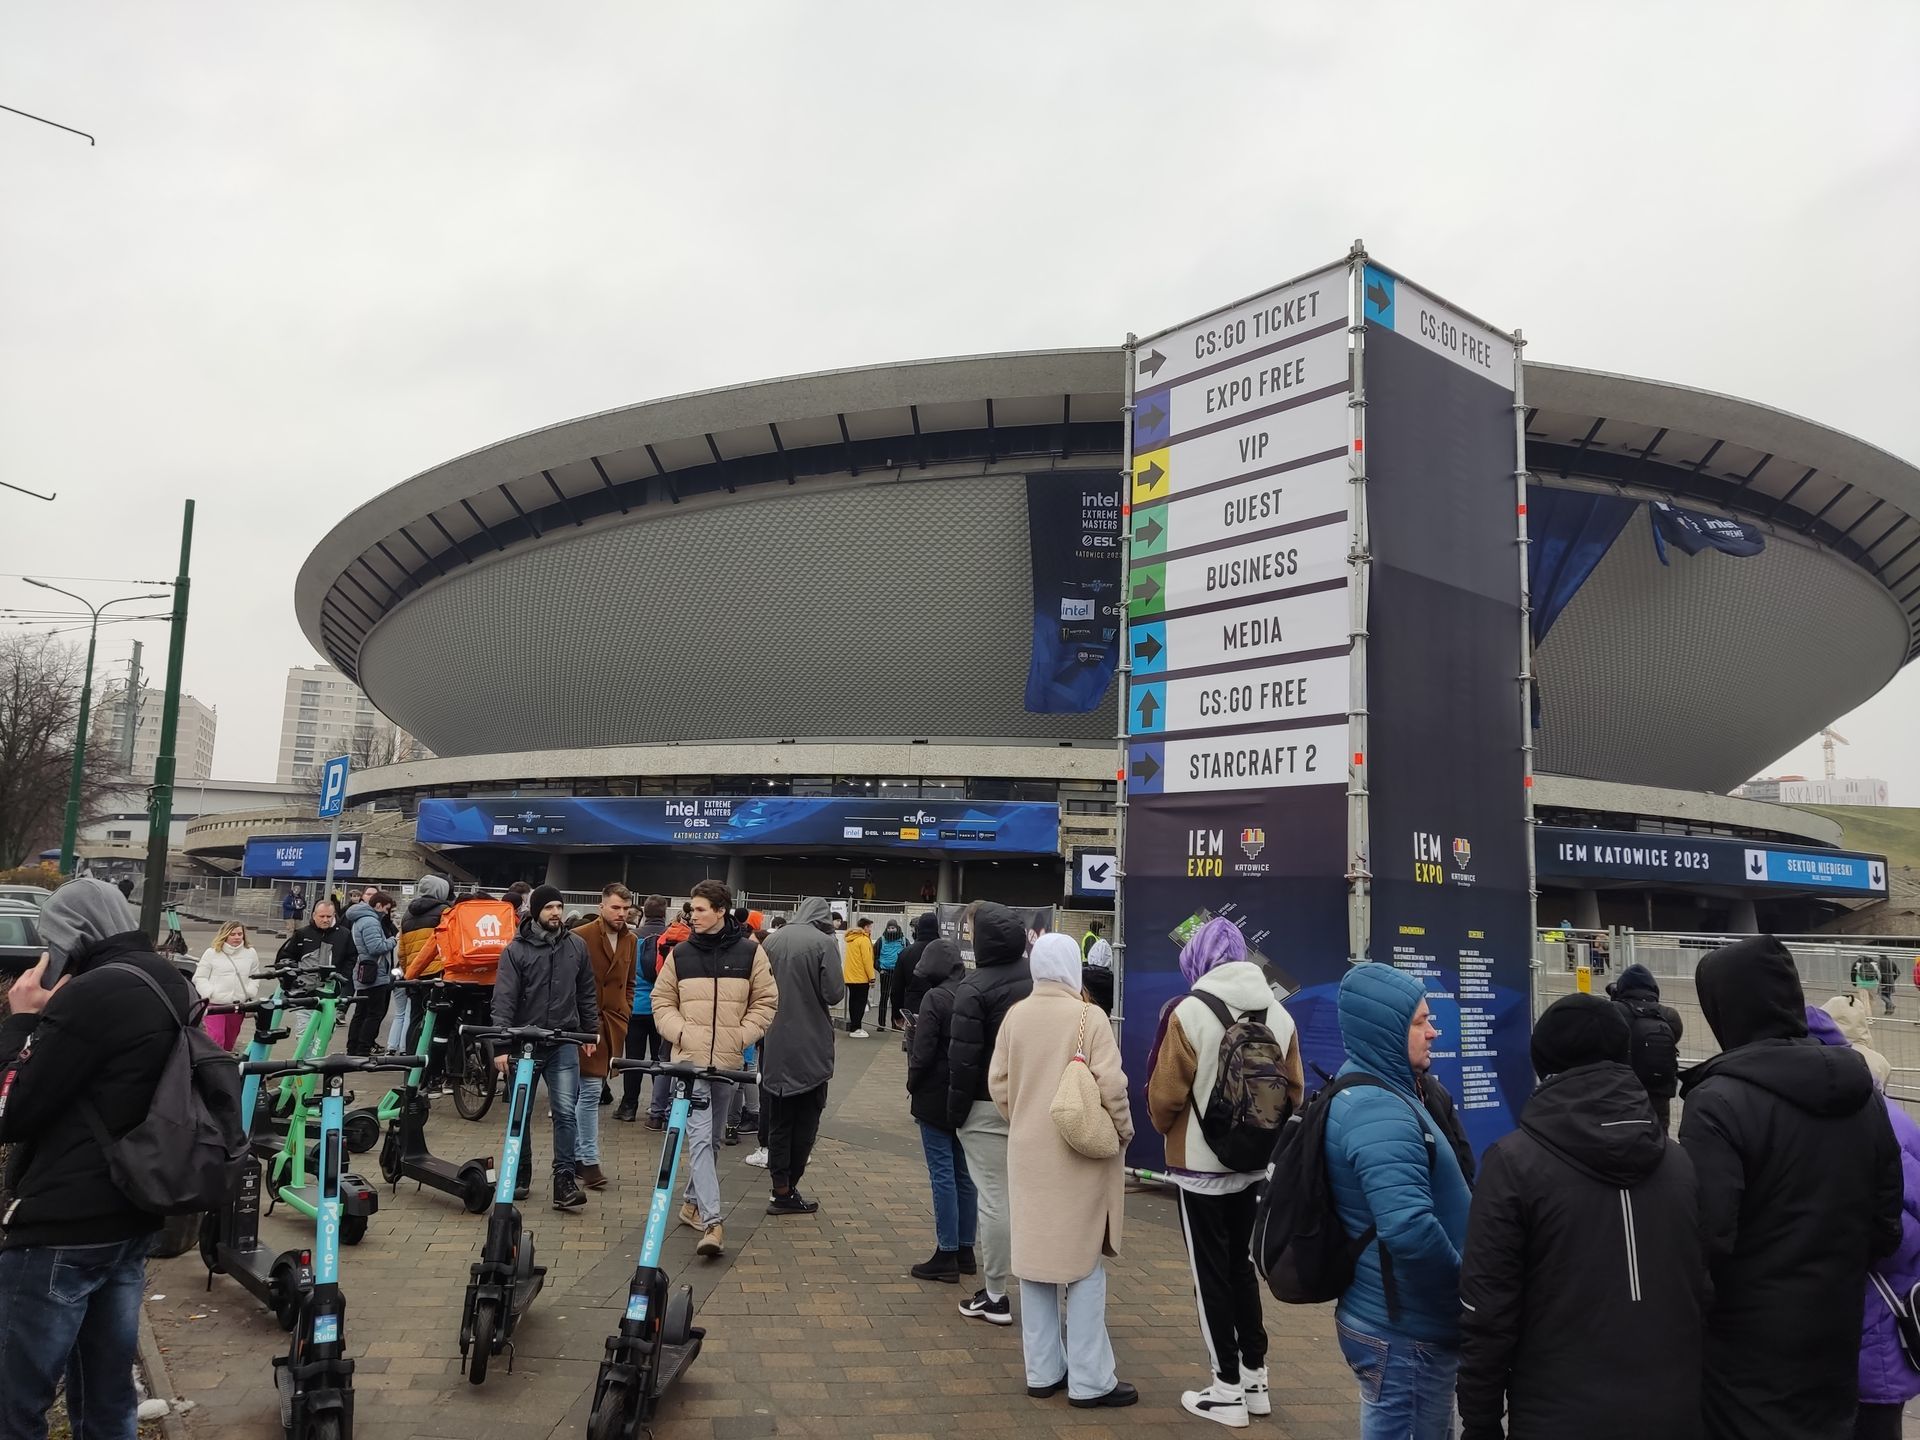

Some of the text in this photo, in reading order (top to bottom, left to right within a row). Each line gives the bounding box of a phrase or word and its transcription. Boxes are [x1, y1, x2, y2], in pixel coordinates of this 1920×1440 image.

[1195, 290, 1320, 359] CS:GO TICKET
[1419, 310, 1491, 369] CS:GO FREE
[1206, 357, 1305, 414] EXPO FREE
[1239, 432, 1269, 463] VIP
[1082, 510, 1118, 519] EXTREME
[1224, 488, 1283, 527] GUEST
[1082, 519, 1118, 530] MASTERS
[1093, 536, 1116, 547] ESL
[1206, 549, 1298, 592] BUSINESS
[1223, 616, 1283, 651] MEDIA
[1199, 678, 1308, 716] CS:GO FREE
[1190, 744, 1317, 780] STARCRAFT 2
[325, 764, 343, 810] P
[704, 800, 732, 808] EXTREME
[704, 808, 731, 816] MASTERS
[693, 819, 710, 827] ESL
[276, 846, 304, 860] WEJŚCIE
[1189, 829, 1223, 856] IEM
[1413, 831, 1442, 863] IEM
[1187, 858, 1223, 877] EXPO
[1234, 863, 1270, 871] KATOWICE
[1559, 843, 1710, 870] IEM KATOWICE 2023
[1787, 859, 1853, 876] SEKTOR NIEBIESKI
[1415, 862, 1443, 885] EXPO
[1451, 872, 1476, 882] KATOWICE
